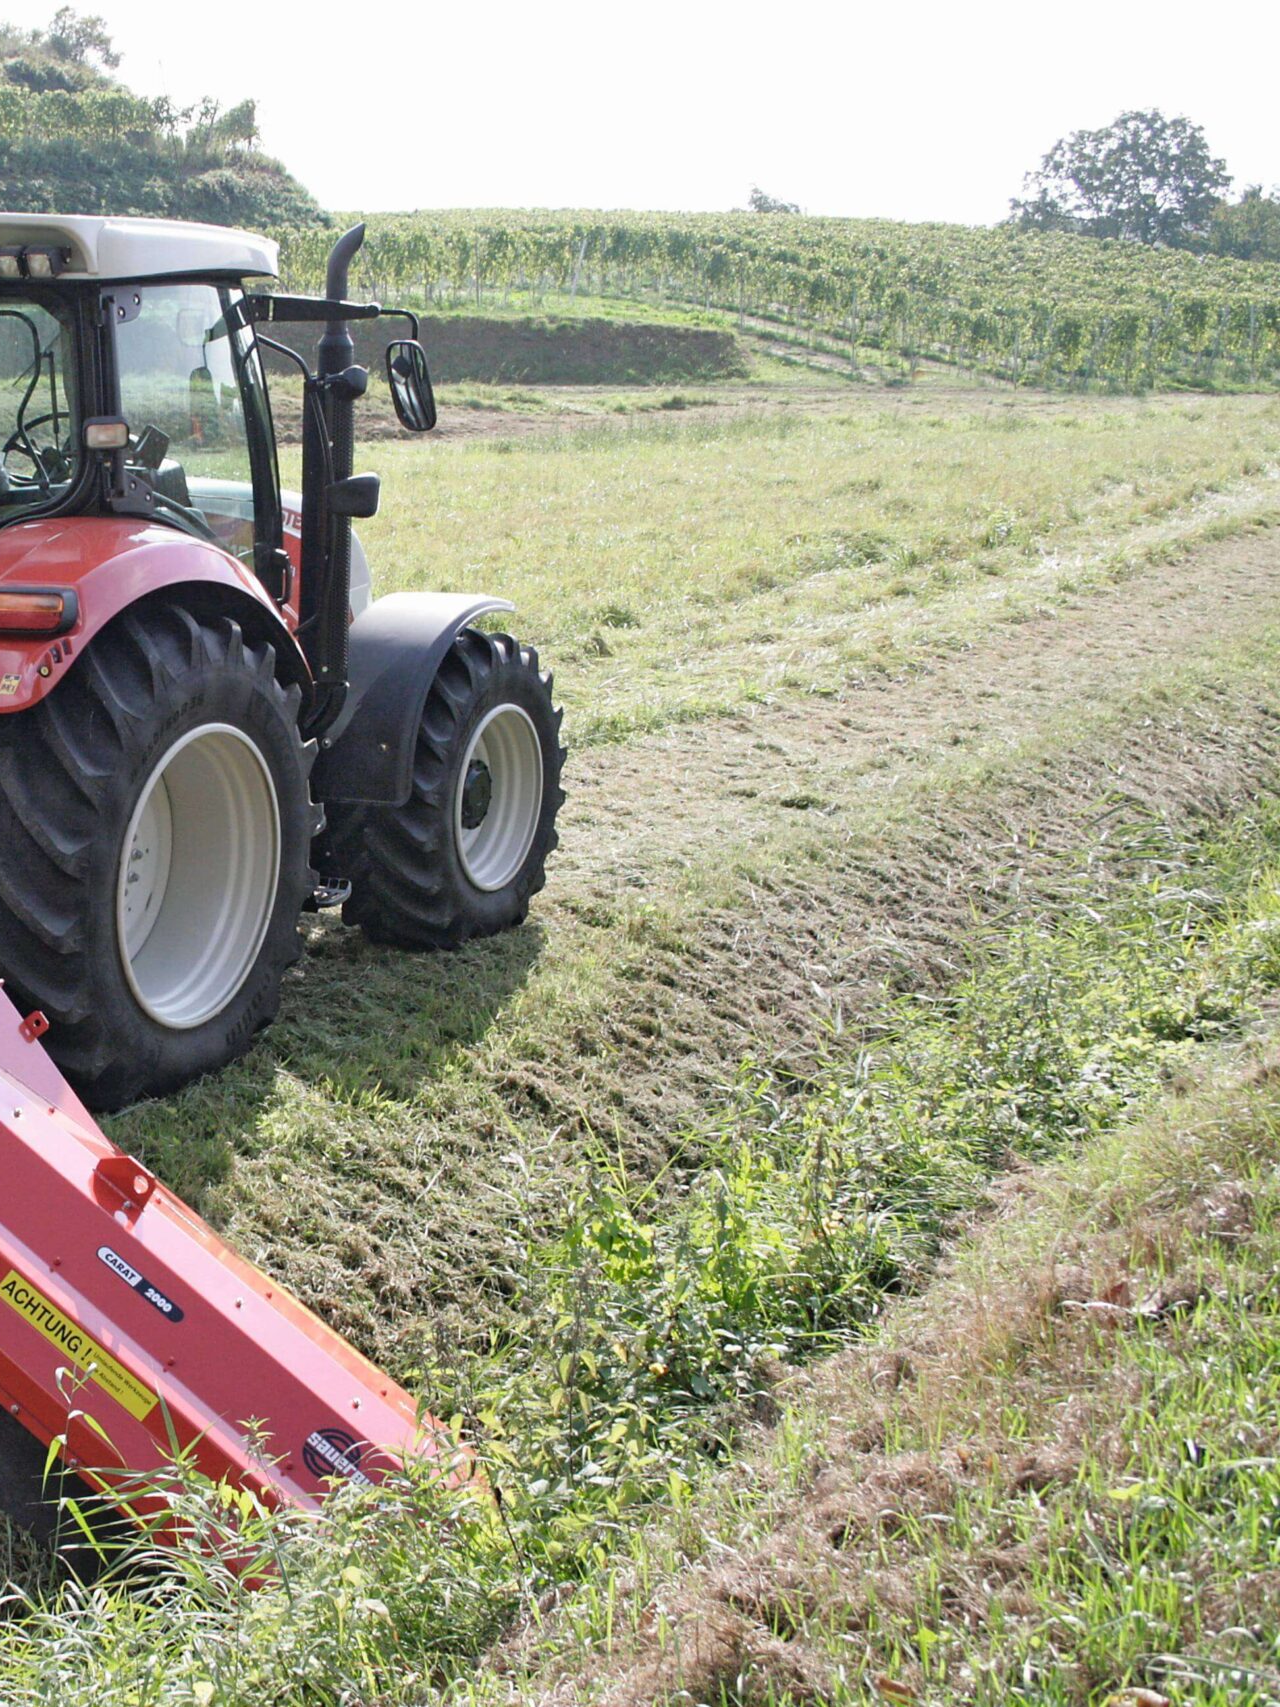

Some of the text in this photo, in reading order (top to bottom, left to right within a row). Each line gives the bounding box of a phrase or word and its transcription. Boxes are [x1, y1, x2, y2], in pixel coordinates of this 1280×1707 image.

[105, 1253, 172, 1312] CARAT 2000
[1, 1280, 83, 1354] ACHTUNG
